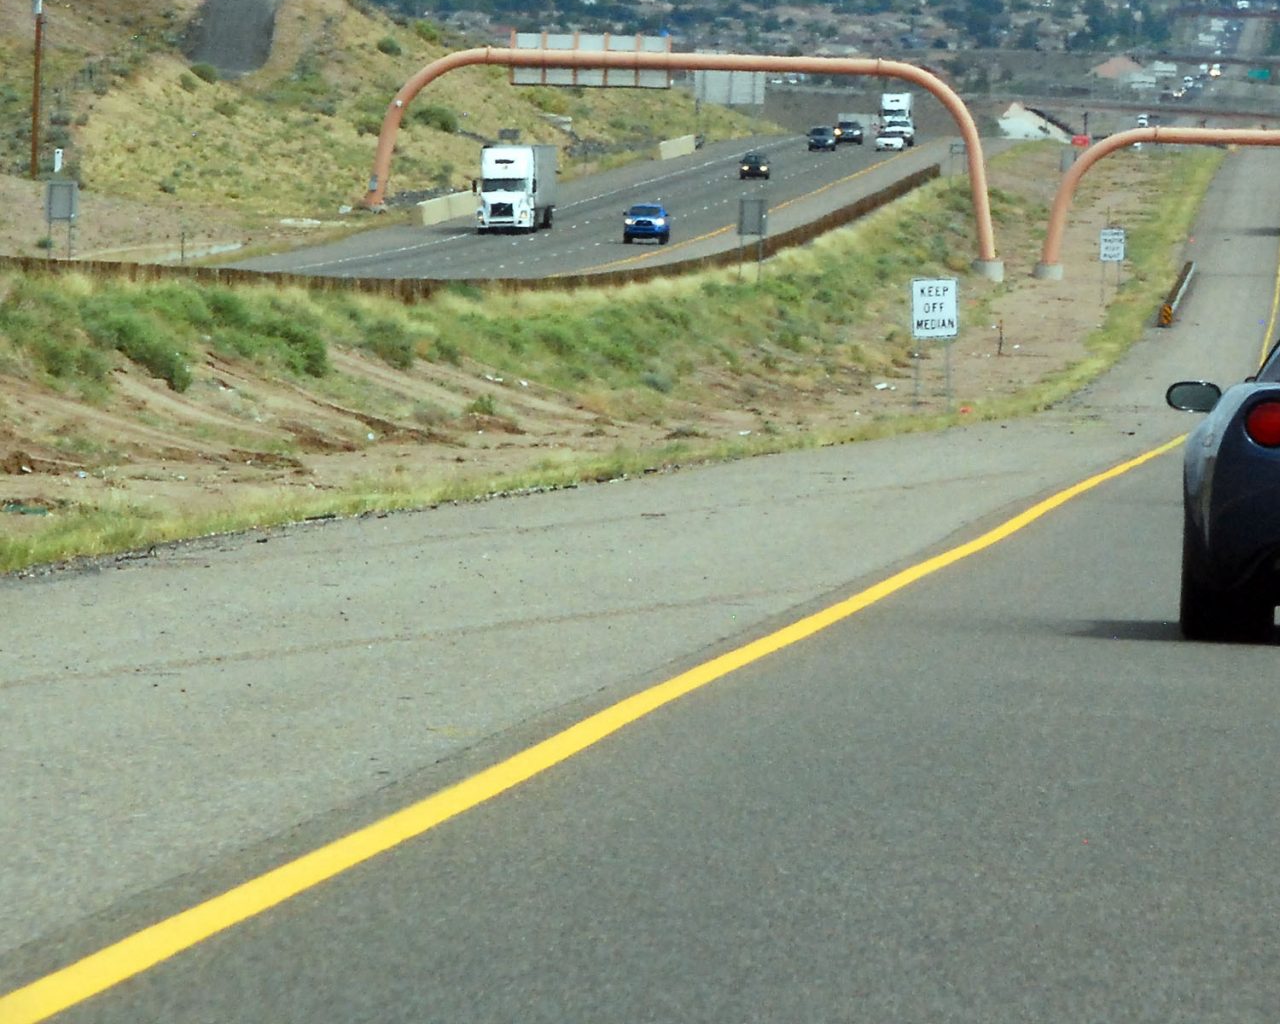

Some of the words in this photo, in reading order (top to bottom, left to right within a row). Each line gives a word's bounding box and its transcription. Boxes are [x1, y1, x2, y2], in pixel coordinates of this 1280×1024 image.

[920, 286, 949, 297] KEEP
[923, 302, 945, 314] OFF
[916, 319, 955, 330] MEDIAN
